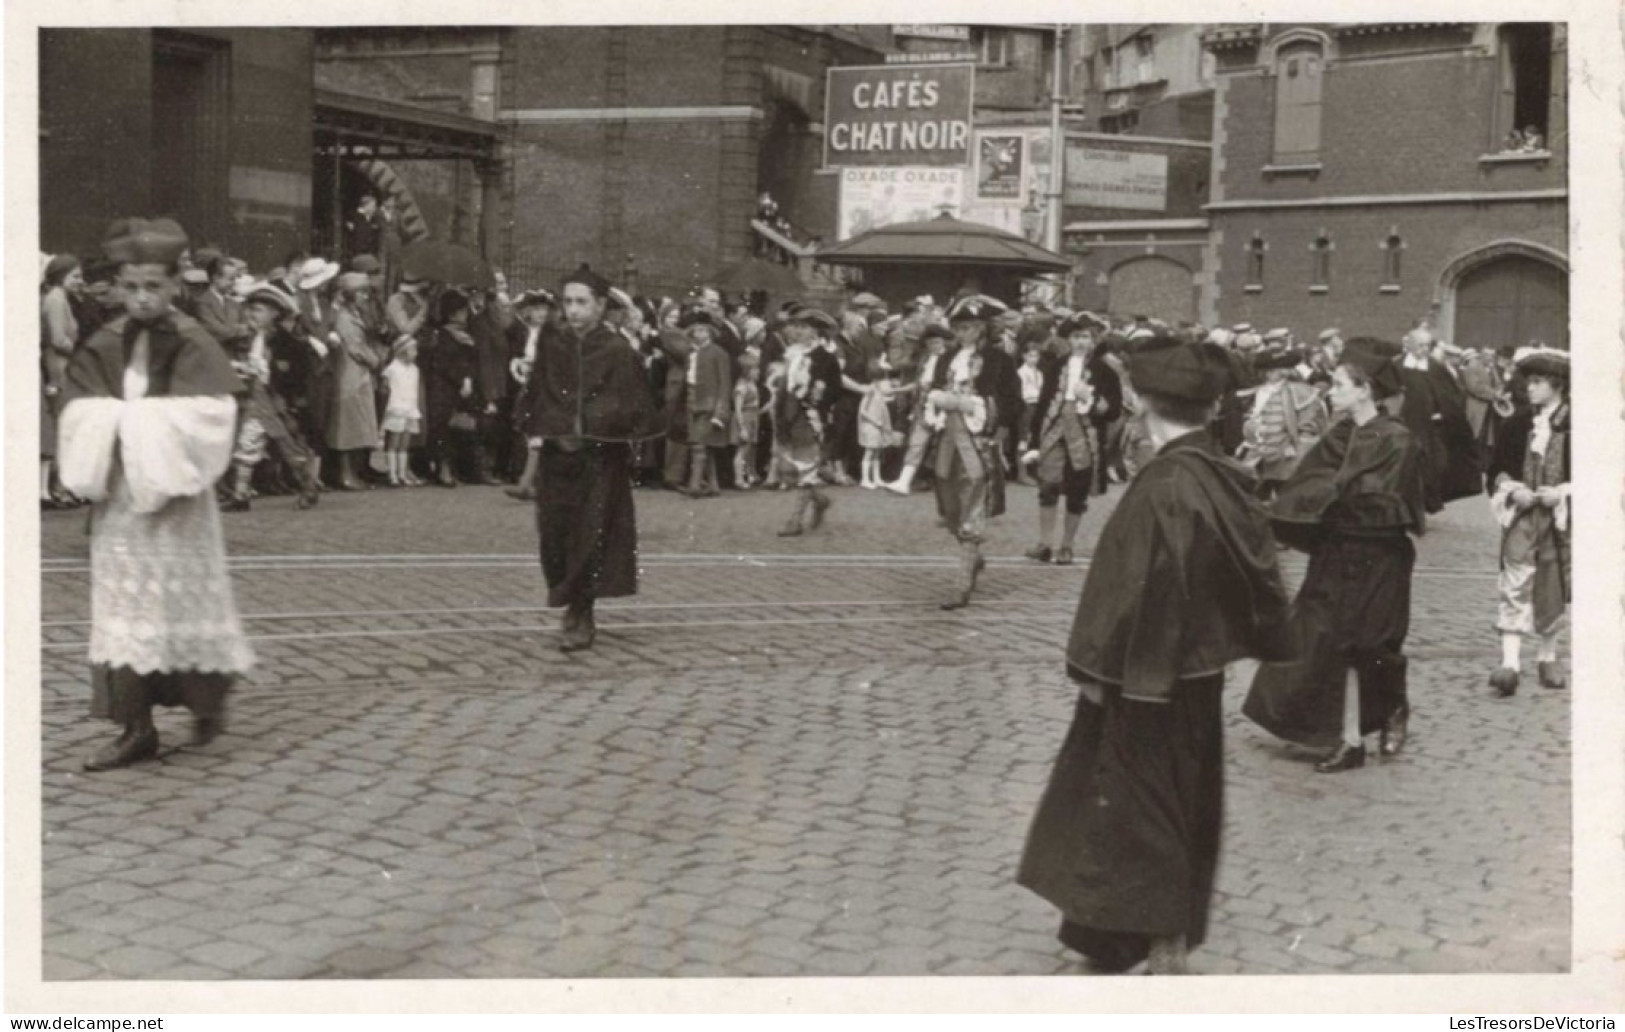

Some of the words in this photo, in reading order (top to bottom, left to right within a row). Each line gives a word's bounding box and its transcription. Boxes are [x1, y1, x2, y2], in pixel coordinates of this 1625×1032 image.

[852, 73, 939, 109] CAFÉS
[830, 122, 898, 151] CHAT
[900, 120, 967, 150] NOIR
